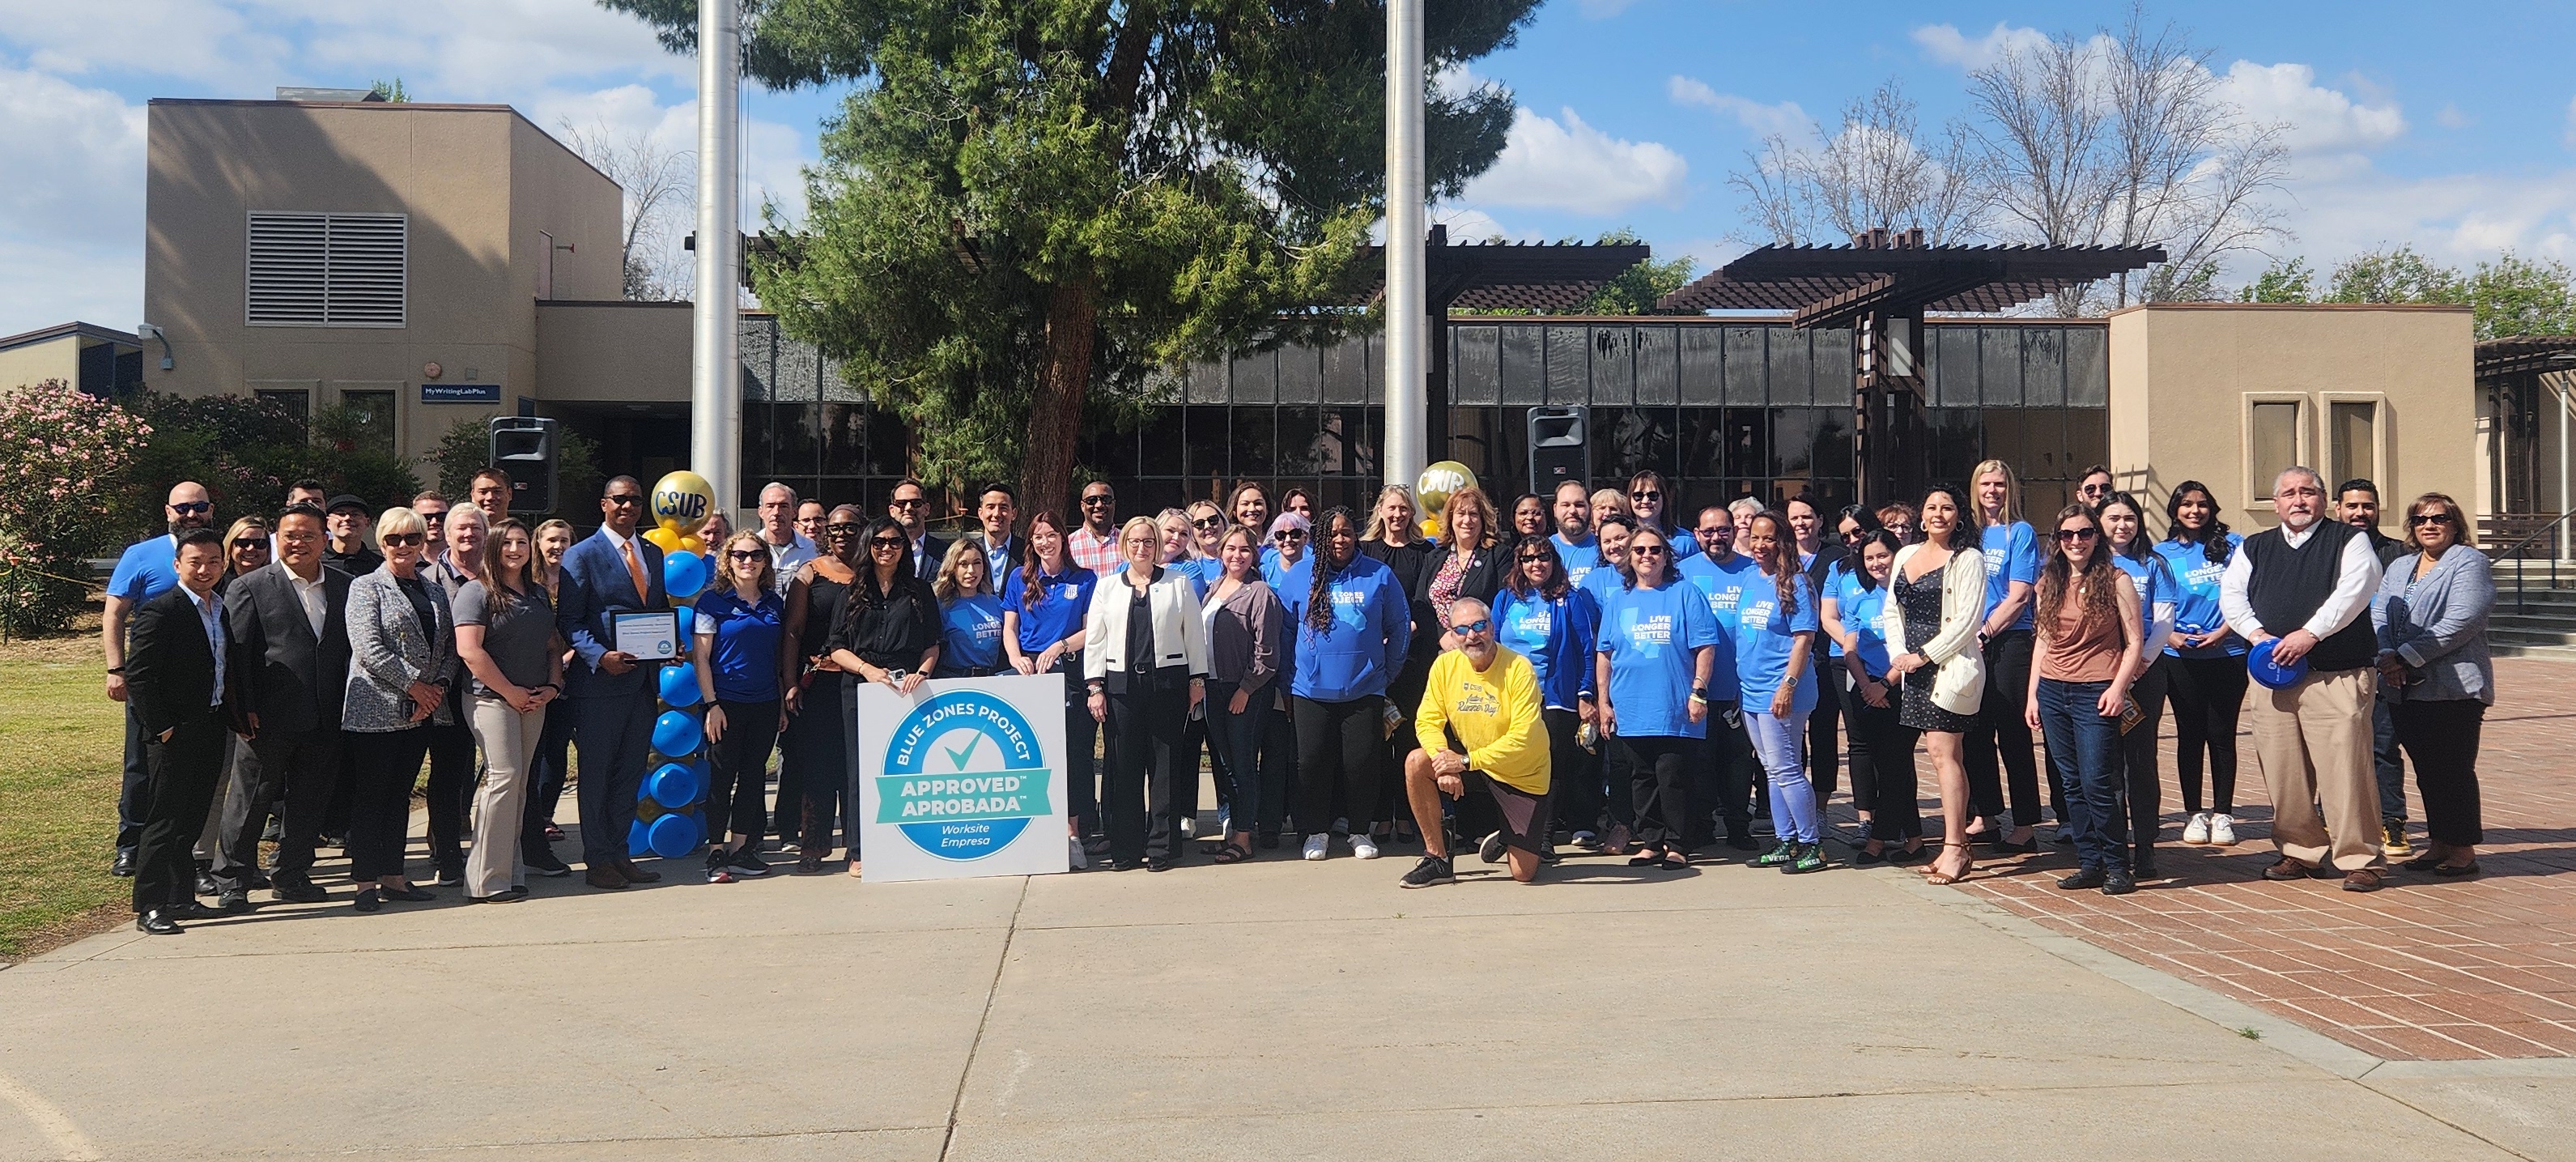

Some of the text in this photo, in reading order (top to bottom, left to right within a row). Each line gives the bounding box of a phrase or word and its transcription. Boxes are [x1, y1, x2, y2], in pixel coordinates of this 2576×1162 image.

[425, 388, 486, 396] MyWritingLabPlus
[655, 491, 708, 519] CSUB
[1986, 548, 2005, 558] LIVE
[1571, 567, 1592, 575] LIVE
[2132, 576, 2149, 584] VE
[2189, 572, 2221, 585] BETTE
[1727, 585, 1742, 594] LIV
[1755, 600, 1775, 610] LIVE
[1741, 607, 1771, 617] LONGER
[1741, 615, 1768, 624] BETTER
[1520, 623, 1550, 631] BETTE
[1631, 623, 1671, 632] LONGER
[976, 629, 1001, 639] BETTE
[1634, 631, 1671, 640] BETTER
[896, 703, 1030, 766] BLUE ZONES PROJECT
[942, 824, 990, 835] Worksite
[941, 837, 990, 849] Empresa
